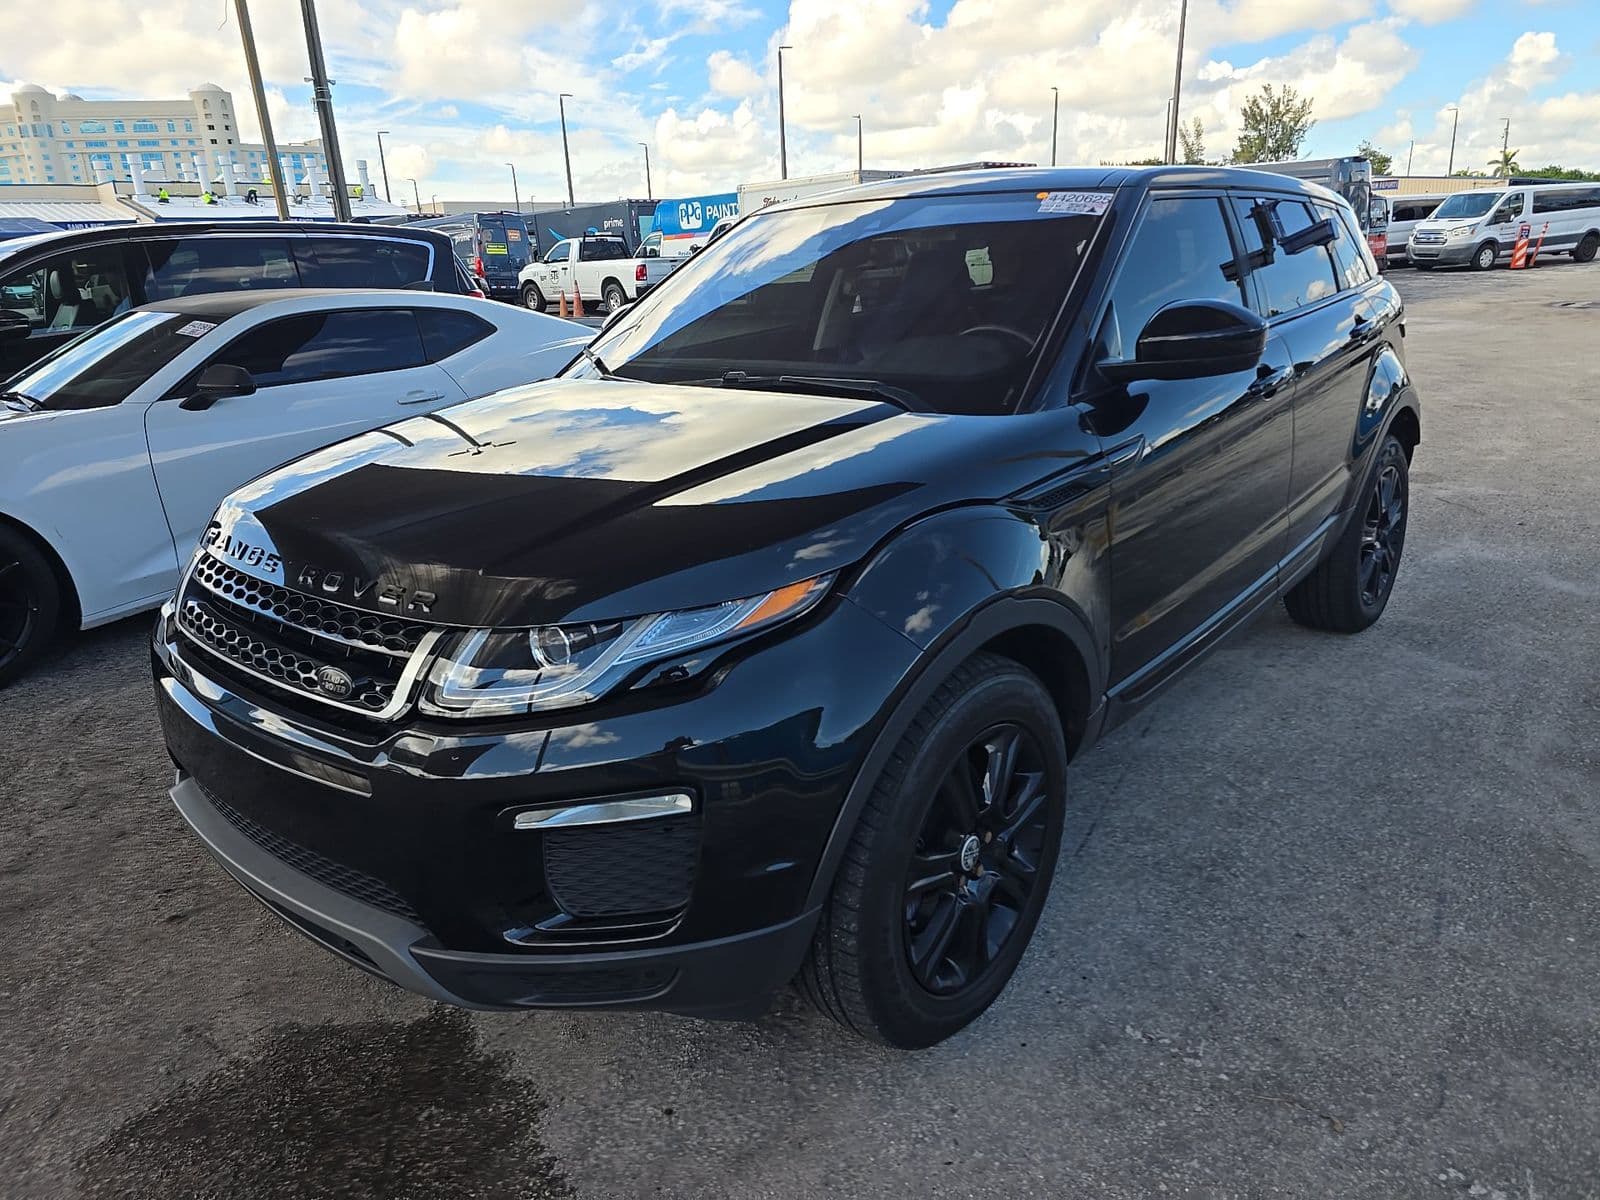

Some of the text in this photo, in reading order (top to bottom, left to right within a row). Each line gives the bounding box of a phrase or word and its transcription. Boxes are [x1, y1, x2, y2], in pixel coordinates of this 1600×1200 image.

[706, 203, 739, 220] PAINT
[603, 218, 624, 230] prime
[298, 563, 439, 613] ROVER
